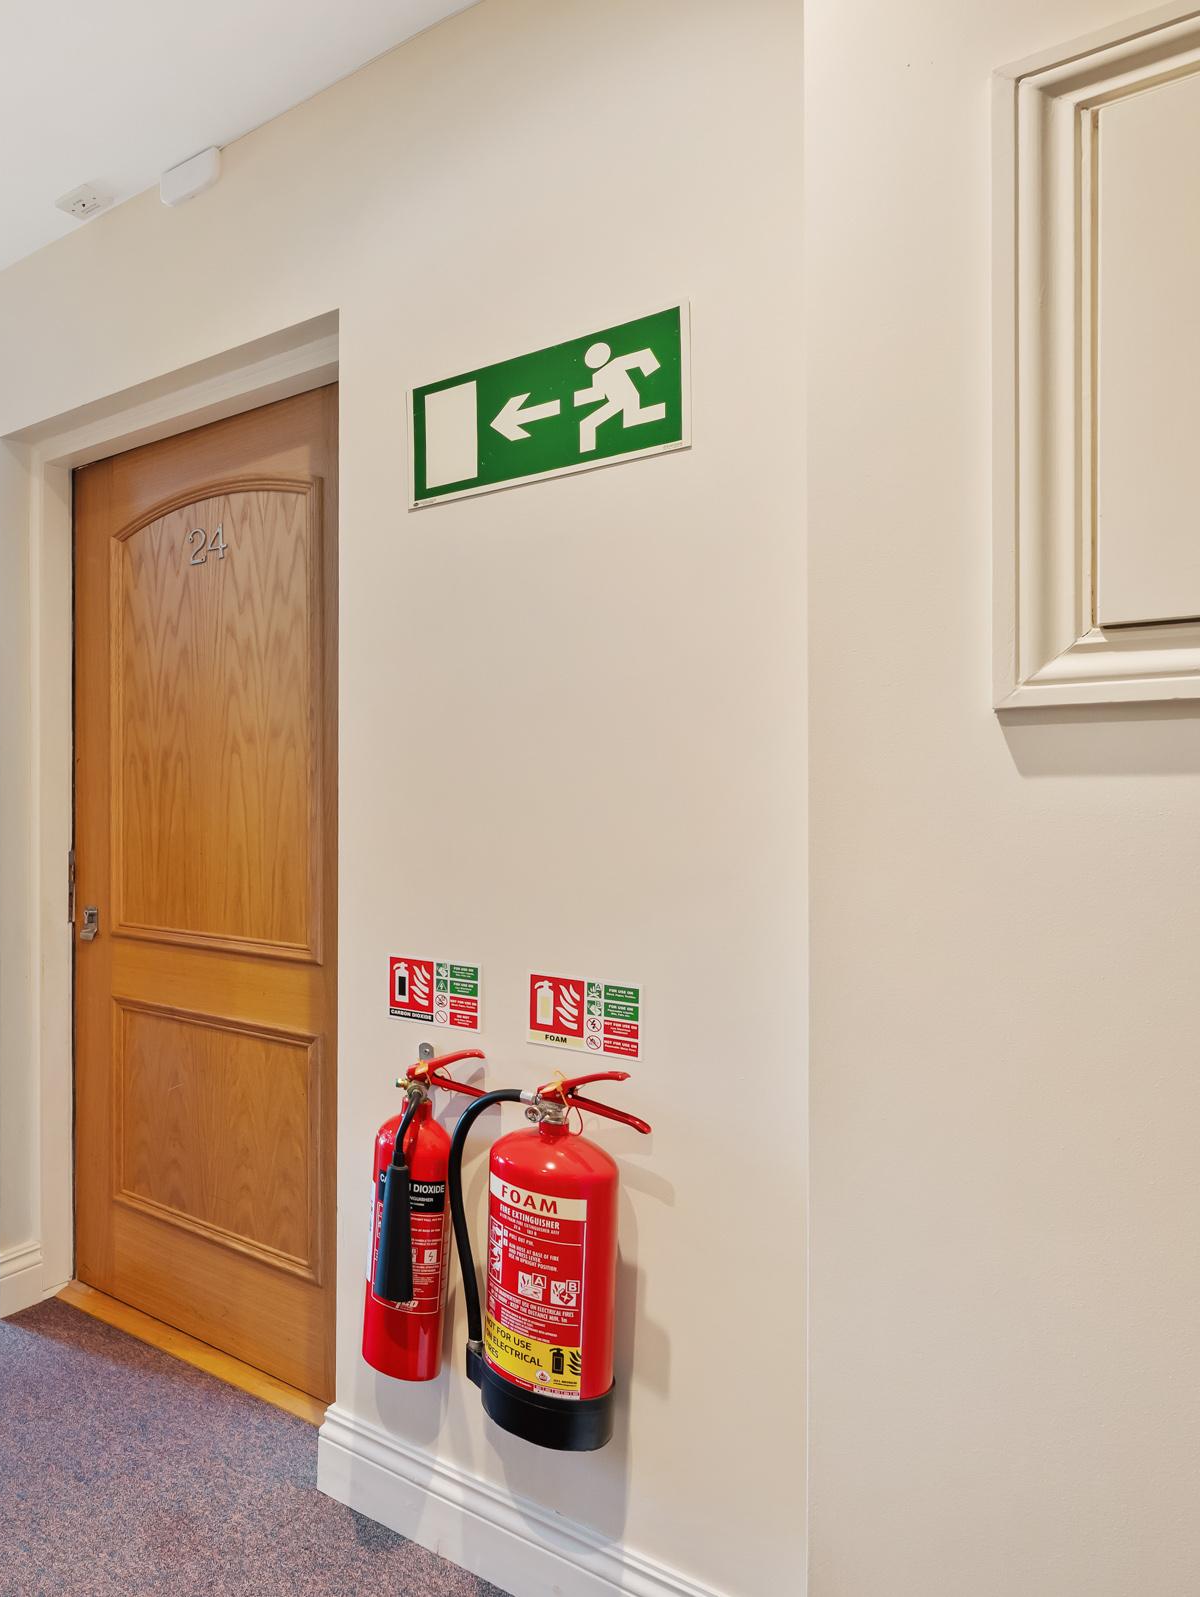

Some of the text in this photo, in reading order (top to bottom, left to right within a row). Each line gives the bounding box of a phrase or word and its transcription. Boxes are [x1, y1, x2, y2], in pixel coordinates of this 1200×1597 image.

[188, 523, 228, 566] 24
[390, 1009, 411, 1017] CARBON
[545, 1034, 567, 1043] FOAM
[413, 1184, 445, 1194] DIOXIDE
[501, 1184, 558, 1214] FOAM
[500, 1204, 560, 1230] FIRE EXTINGUISHER
[534, 1277, 544, 1286] A
[568, 1283, 576, 1291] B
[497, 1326, 512, 1342] FOR
[514, 1335, 532, 1351] USE
[493, 1336, 543, 1367] ELECTRICAL
